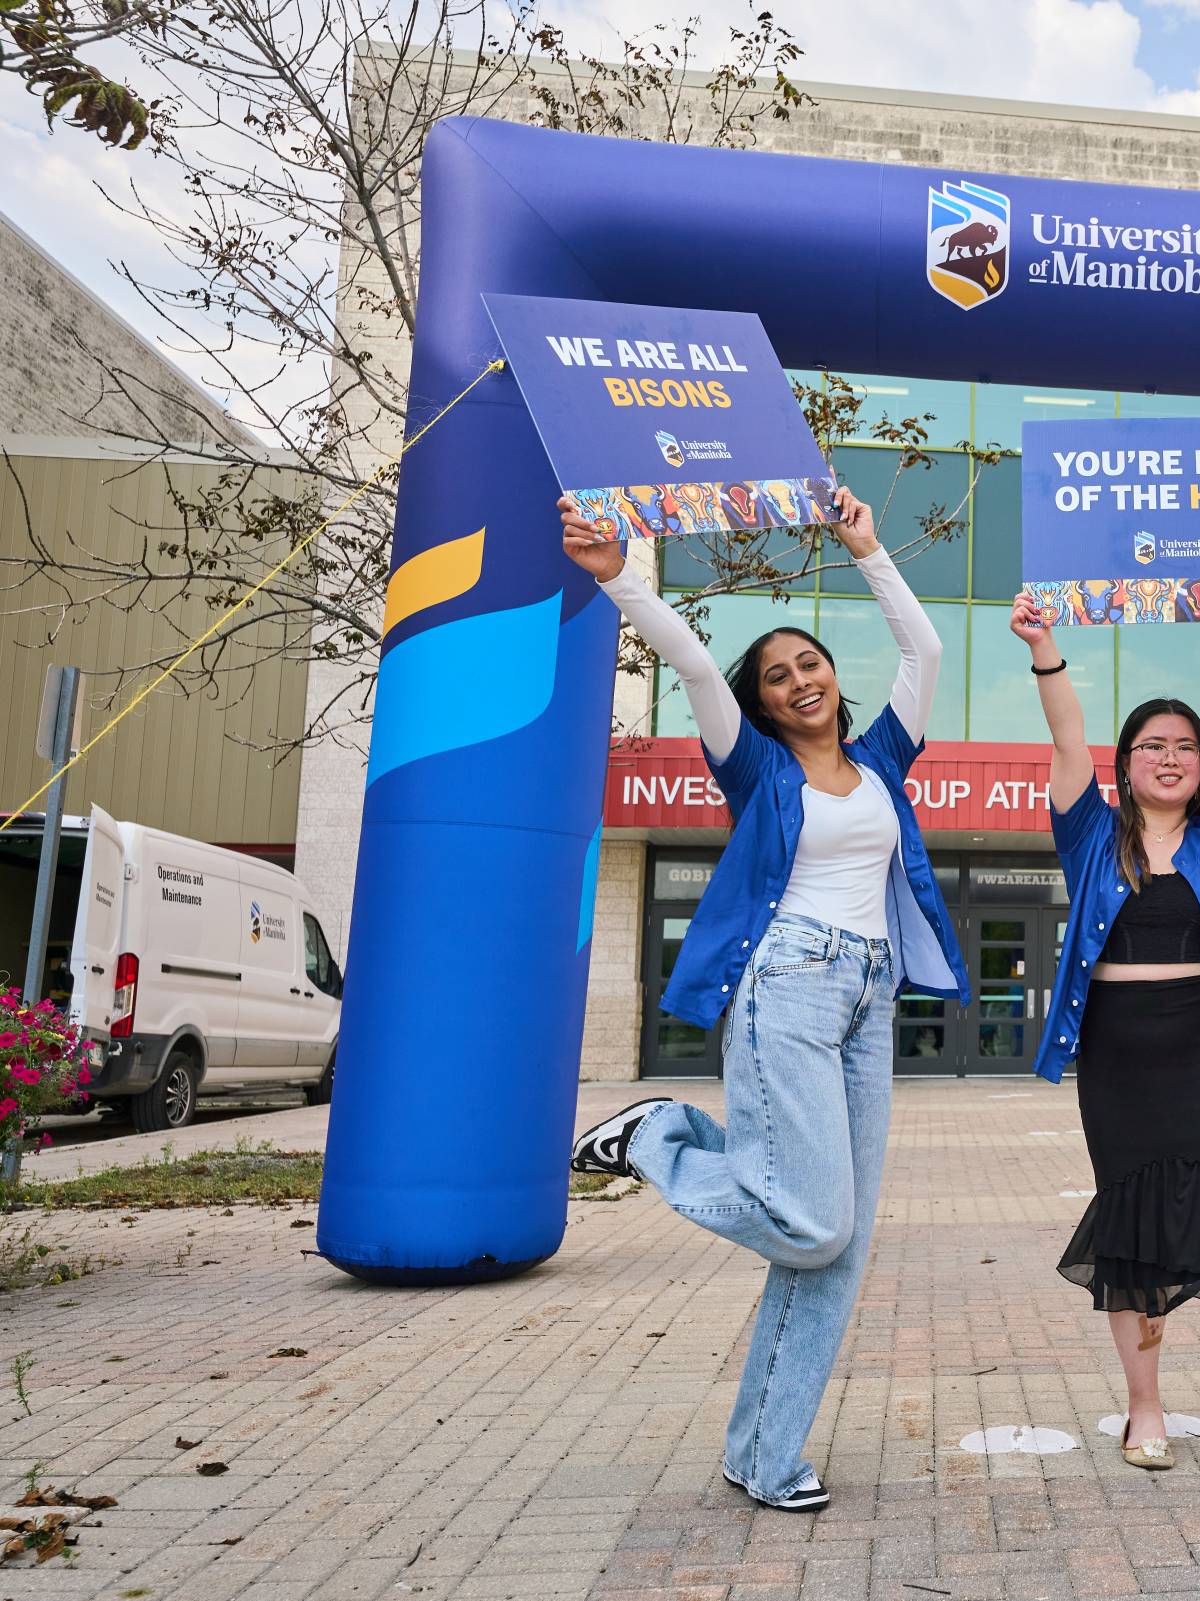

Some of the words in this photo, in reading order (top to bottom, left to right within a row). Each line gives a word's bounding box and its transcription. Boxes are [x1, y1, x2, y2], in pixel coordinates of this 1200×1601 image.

[1029, 257, 1050, 283] of
[546, 336, 612, 367] WE
[617, 339, 685, 370] ARE
[688, 344, 748, 373] ALL
[603, 377, 732, 409] BISONS
[681, 440, 727, 451] University
[691, 450, 732, 459] Manitoba
[1053, 450, 1183, 477] YOU'RE
[1055, 485, 1102, 512] OF
[1110, 484, 1180, 510] THE
[623, 775, 727, 806] INVES
[903, 778, 971, 808] OUP
[157, 865, 192, 884] Operations
[193, 873, 204, 886] and
[669, 868, 712, 882] GOBI
[977, 874, 1065, 886] #WEAREALLB
[162, 887, 202, 906] Maintenance
